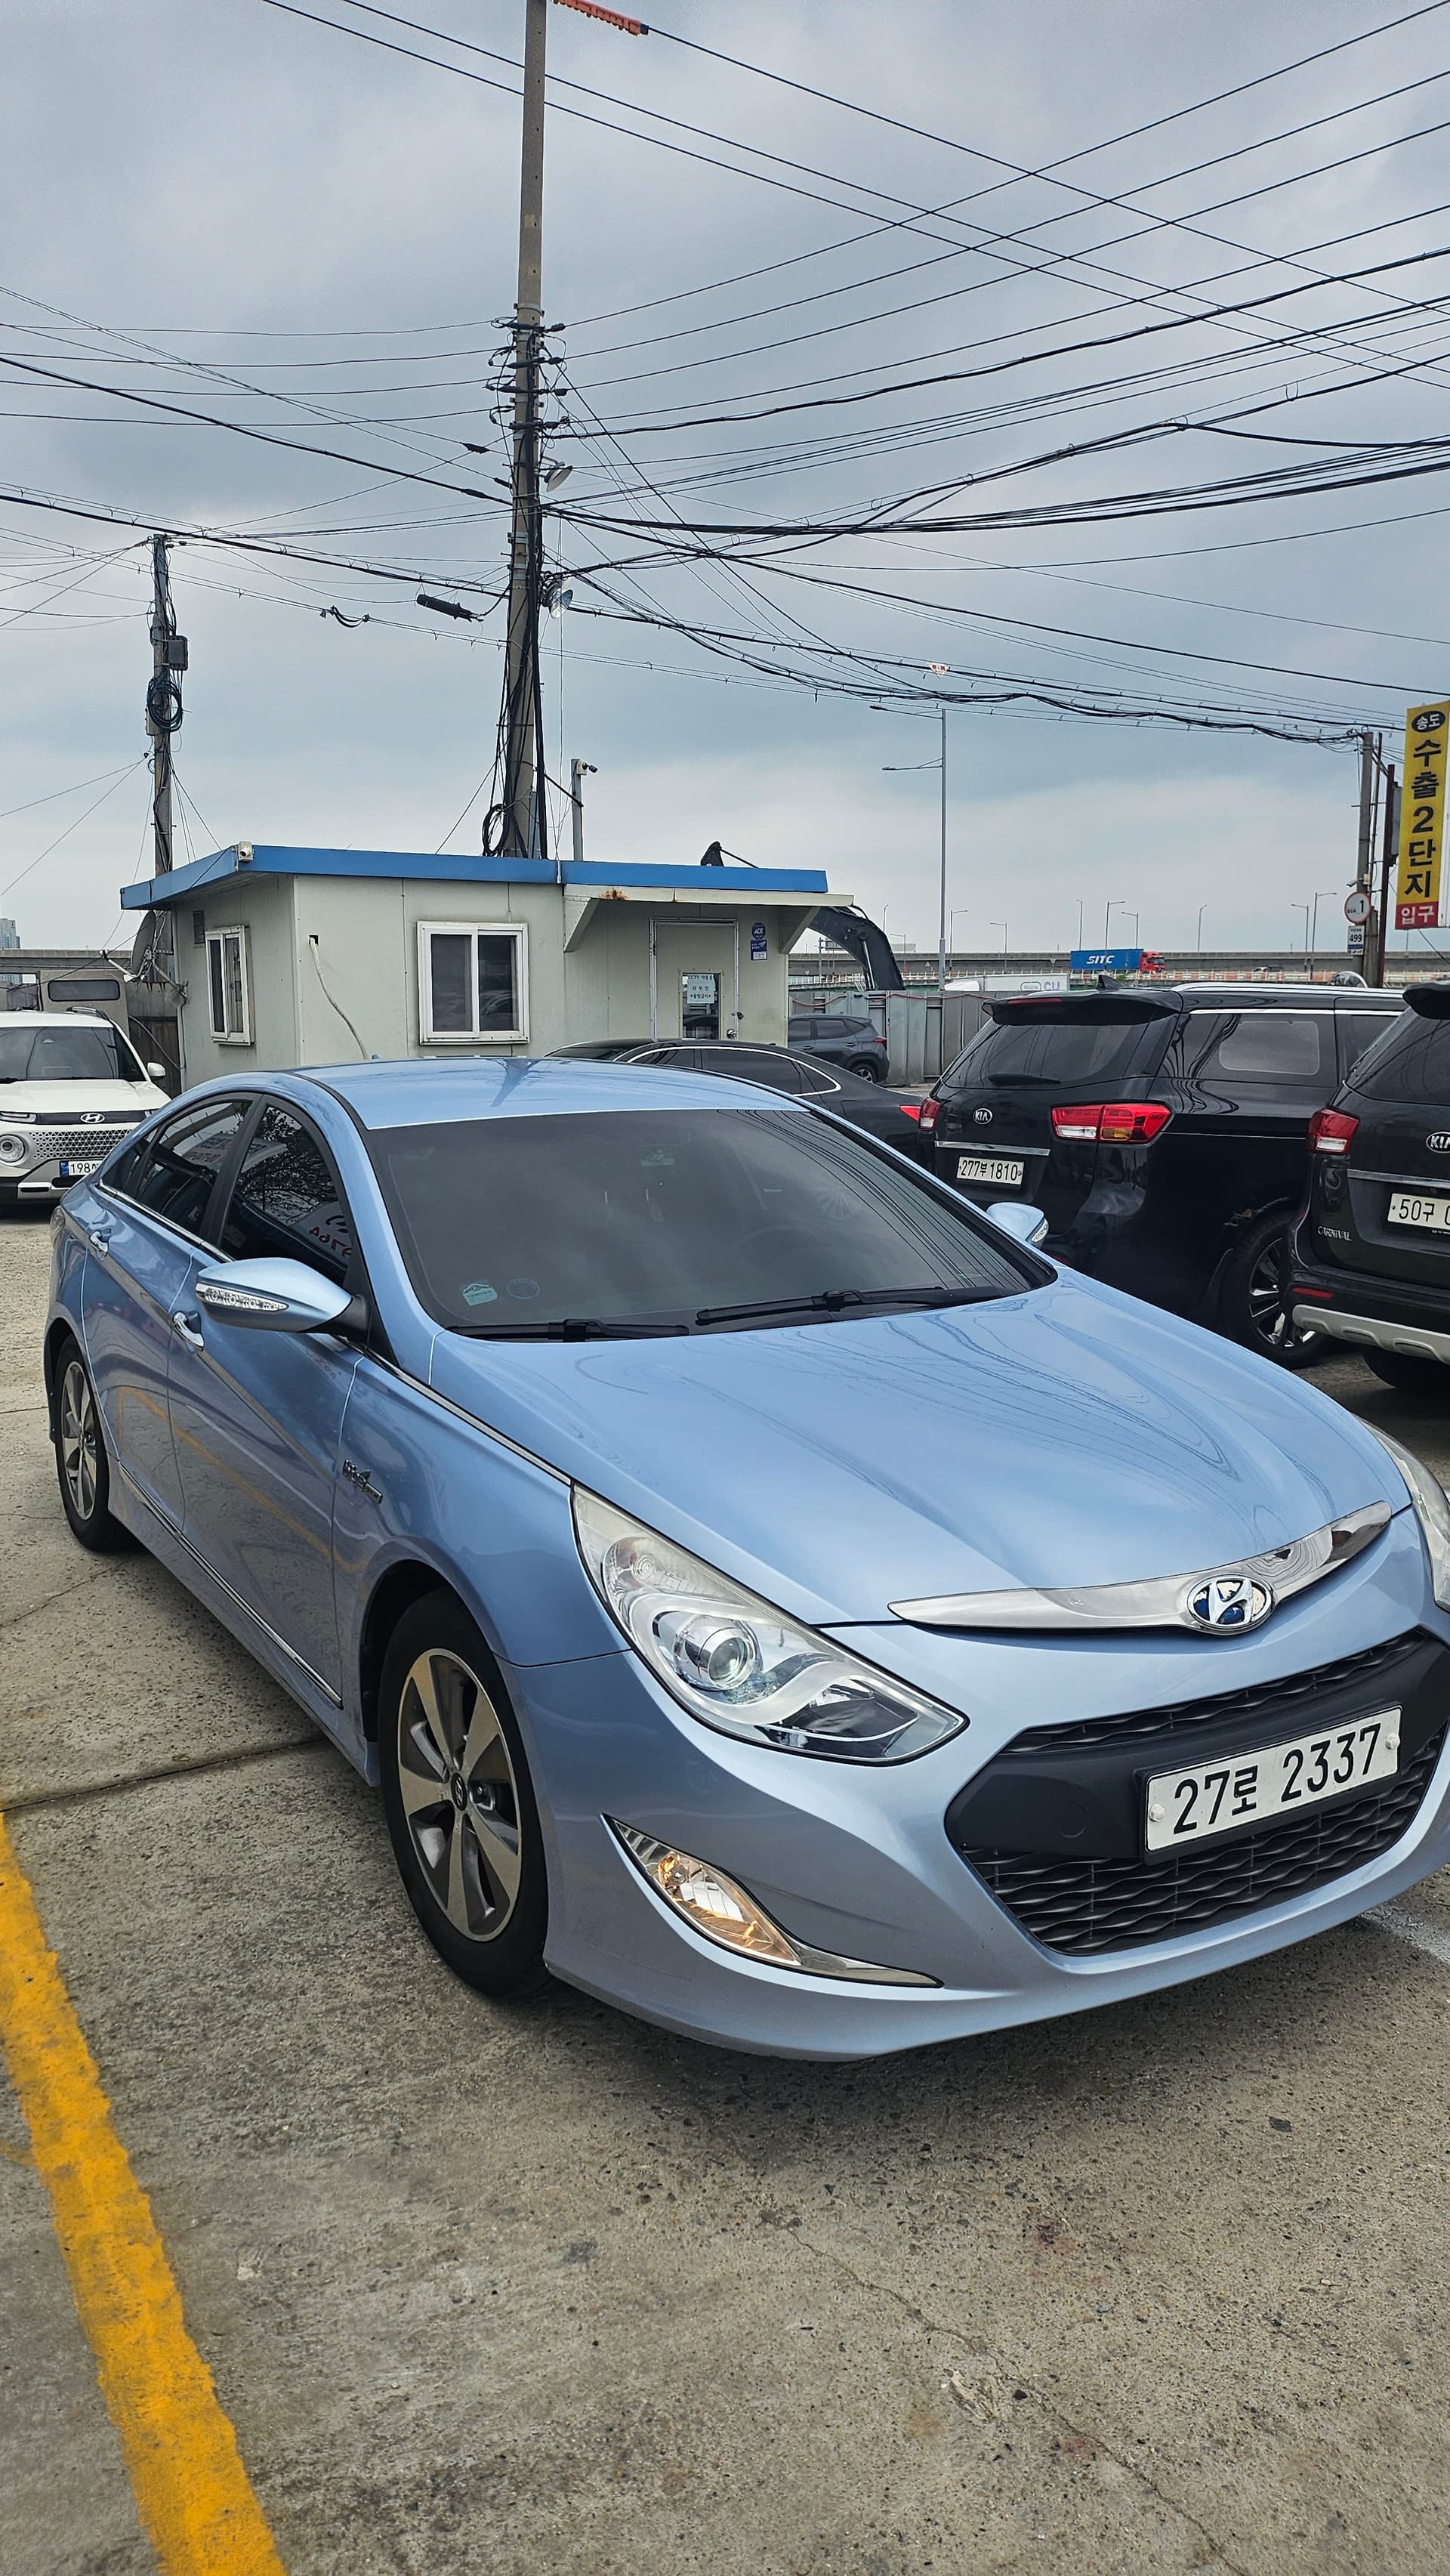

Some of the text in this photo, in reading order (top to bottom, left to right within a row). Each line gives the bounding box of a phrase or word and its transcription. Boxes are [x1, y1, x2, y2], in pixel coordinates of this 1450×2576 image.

[1416, 714, 1440, 730] 송도
[1405, 739, 1442, 898] 수출2단지
[1401, 906, 1435, 925] 입구
[1086, 955, 1115, 965] SITC
[975, 1110, 989, 1121] KIA
[1318, 1226, 1353, 1241] CARNIVAL
[1174, 1722, 1382, 1835] 27로 2337
